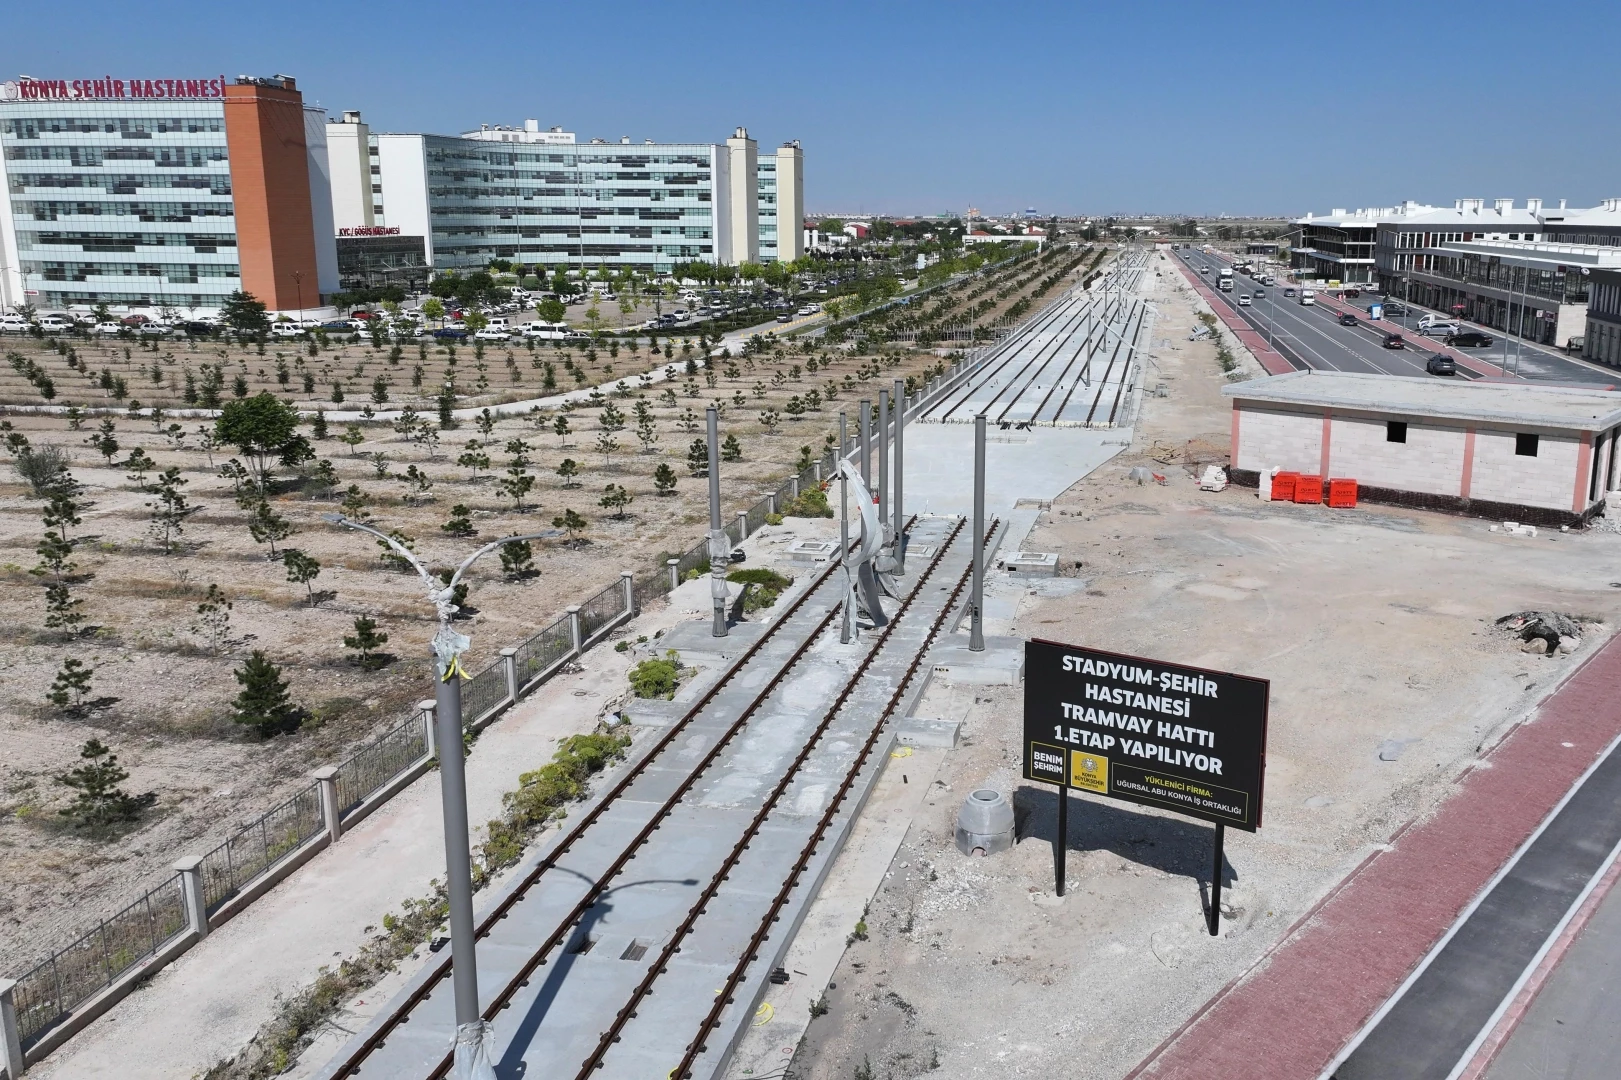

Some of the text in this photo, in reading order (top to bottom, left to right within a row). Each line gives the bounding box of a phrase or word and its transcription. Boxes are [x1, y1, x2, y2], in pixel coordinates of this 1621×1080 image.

[20, 80, 69, 98] KONYA
[130, 74, 226, 97] HASTANESİ
[1062, 655, 1218, 698] STADYUM-ŞEHİR
[1085, 683, 1190, 717] HASTANESİ
[1061, 702, 1215, 748] TRAMVAY HATTI
[1034, 751, 1063, 765] BENİM
[1054, 725, 1223, 775] 1.ETAP YAPILIYOR
[1034, 761, 1063, 774] ŞEHRİM
[1116, 780, 1242, 815] UĞURSAL ABU KONYA İŞ ORTAKLIĞI
[1144, 775, 1213, 798] YÜKLENİCİ FİRMA:
